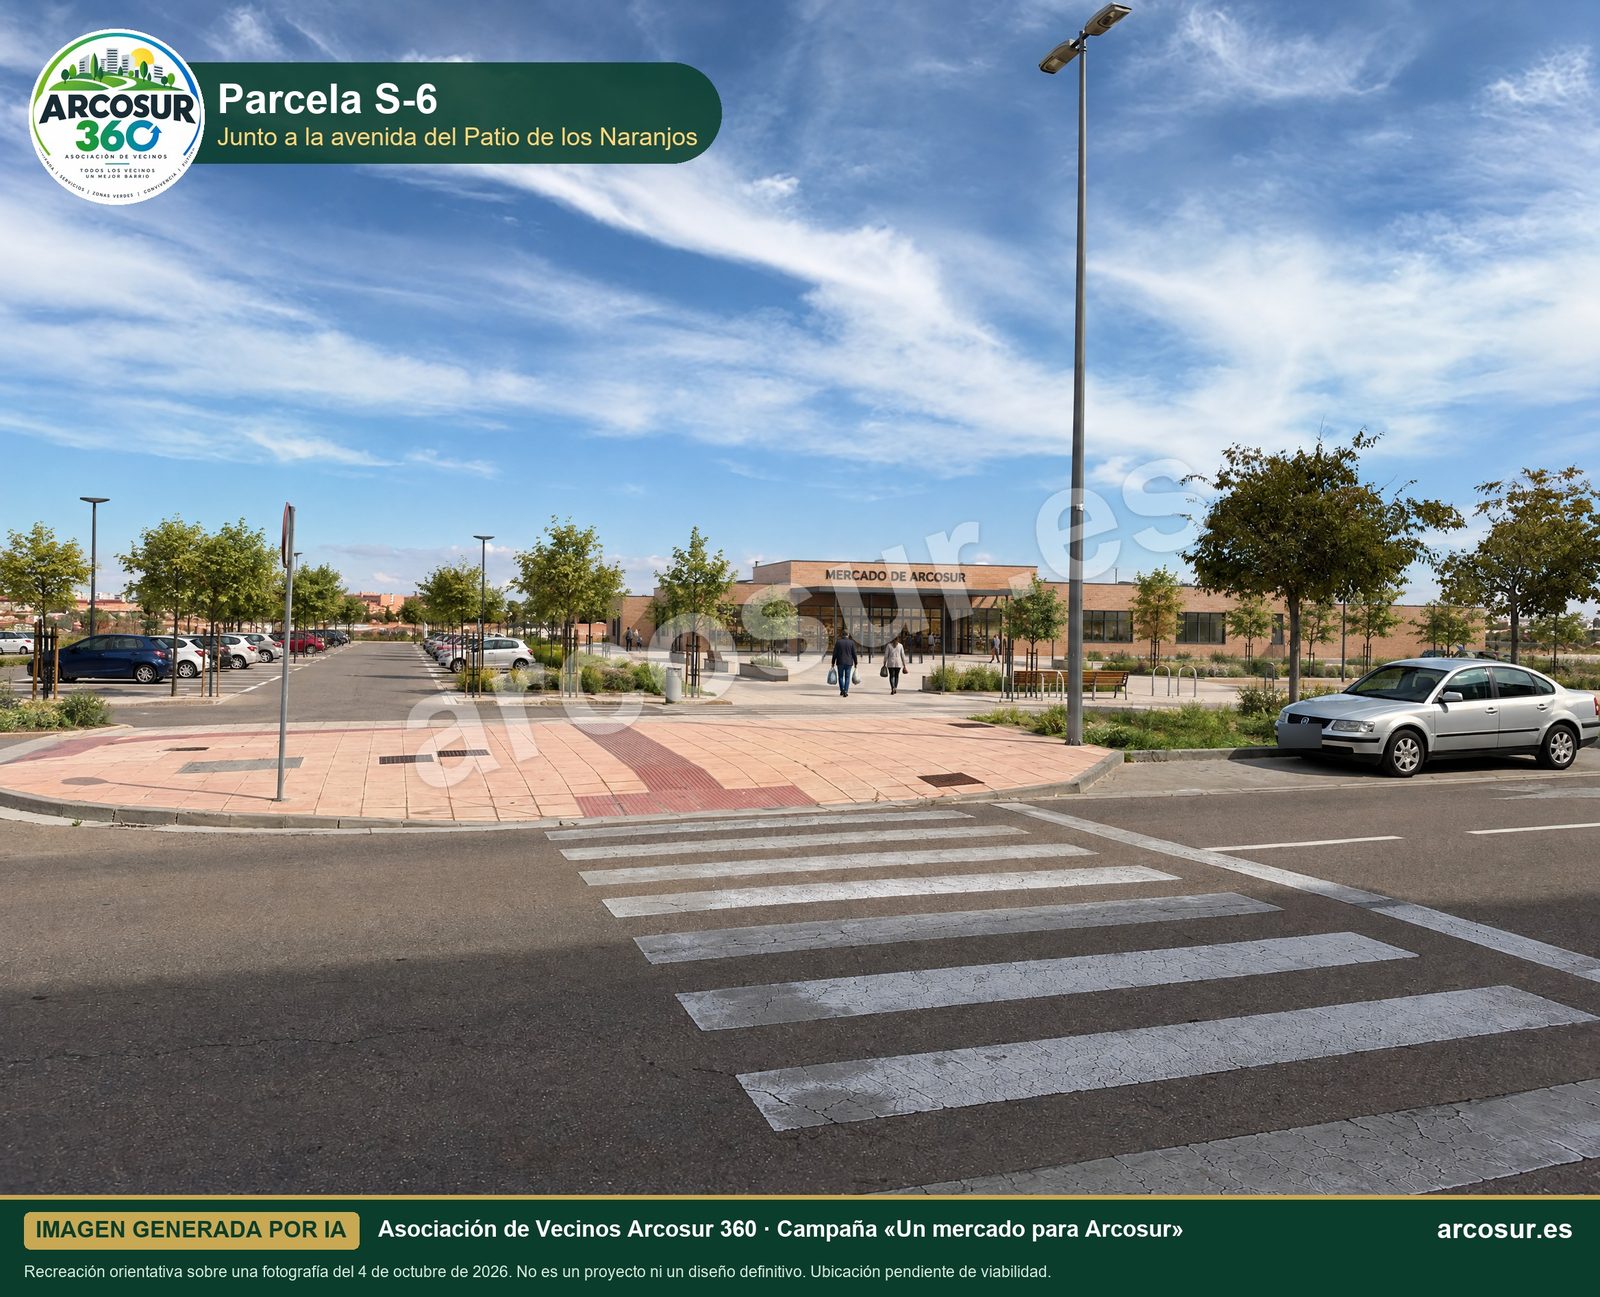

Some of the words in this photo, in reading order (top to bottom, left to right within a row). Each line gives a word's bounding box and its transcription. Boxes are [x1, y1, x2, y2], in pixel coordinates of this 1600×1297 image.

[825, 569, 887, 581] MERCADO
[890, 571, 907, 582] DE
[909, 571, 966, 583] ARCOSUR
